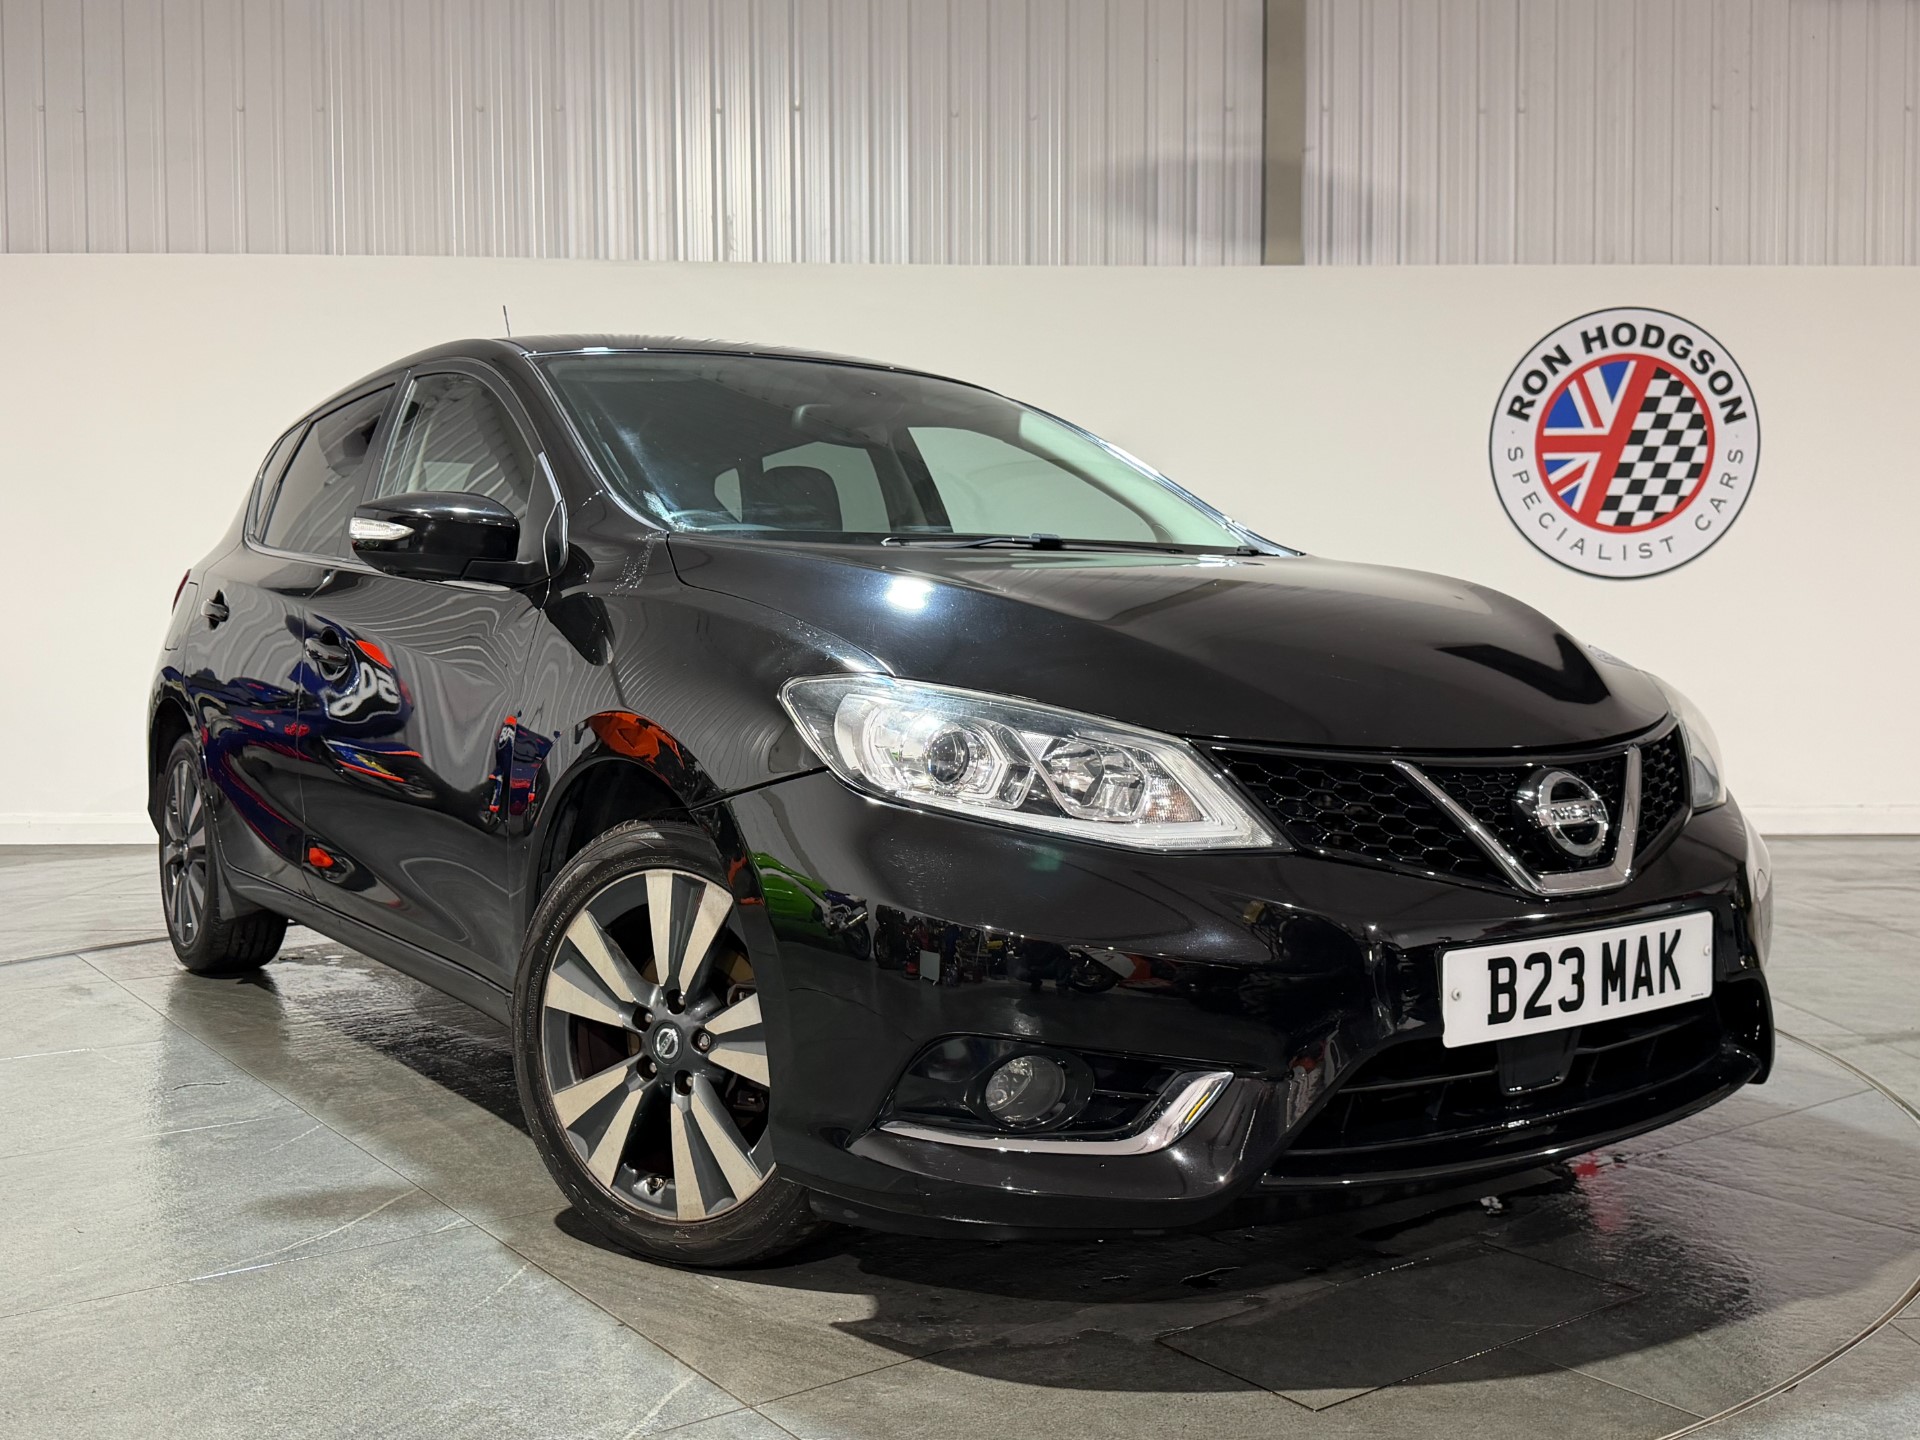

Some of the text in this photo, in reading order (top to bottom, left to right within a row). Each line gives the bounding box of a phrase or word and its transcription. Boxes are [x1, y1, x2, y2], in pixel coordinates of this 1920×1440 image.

[1507, 322, 1747, 424] RON HODGSON
[1507, 446, 1744, 560] SPECIALIST CARS
[1487, 929, 1682, 1026] B23 MAK
